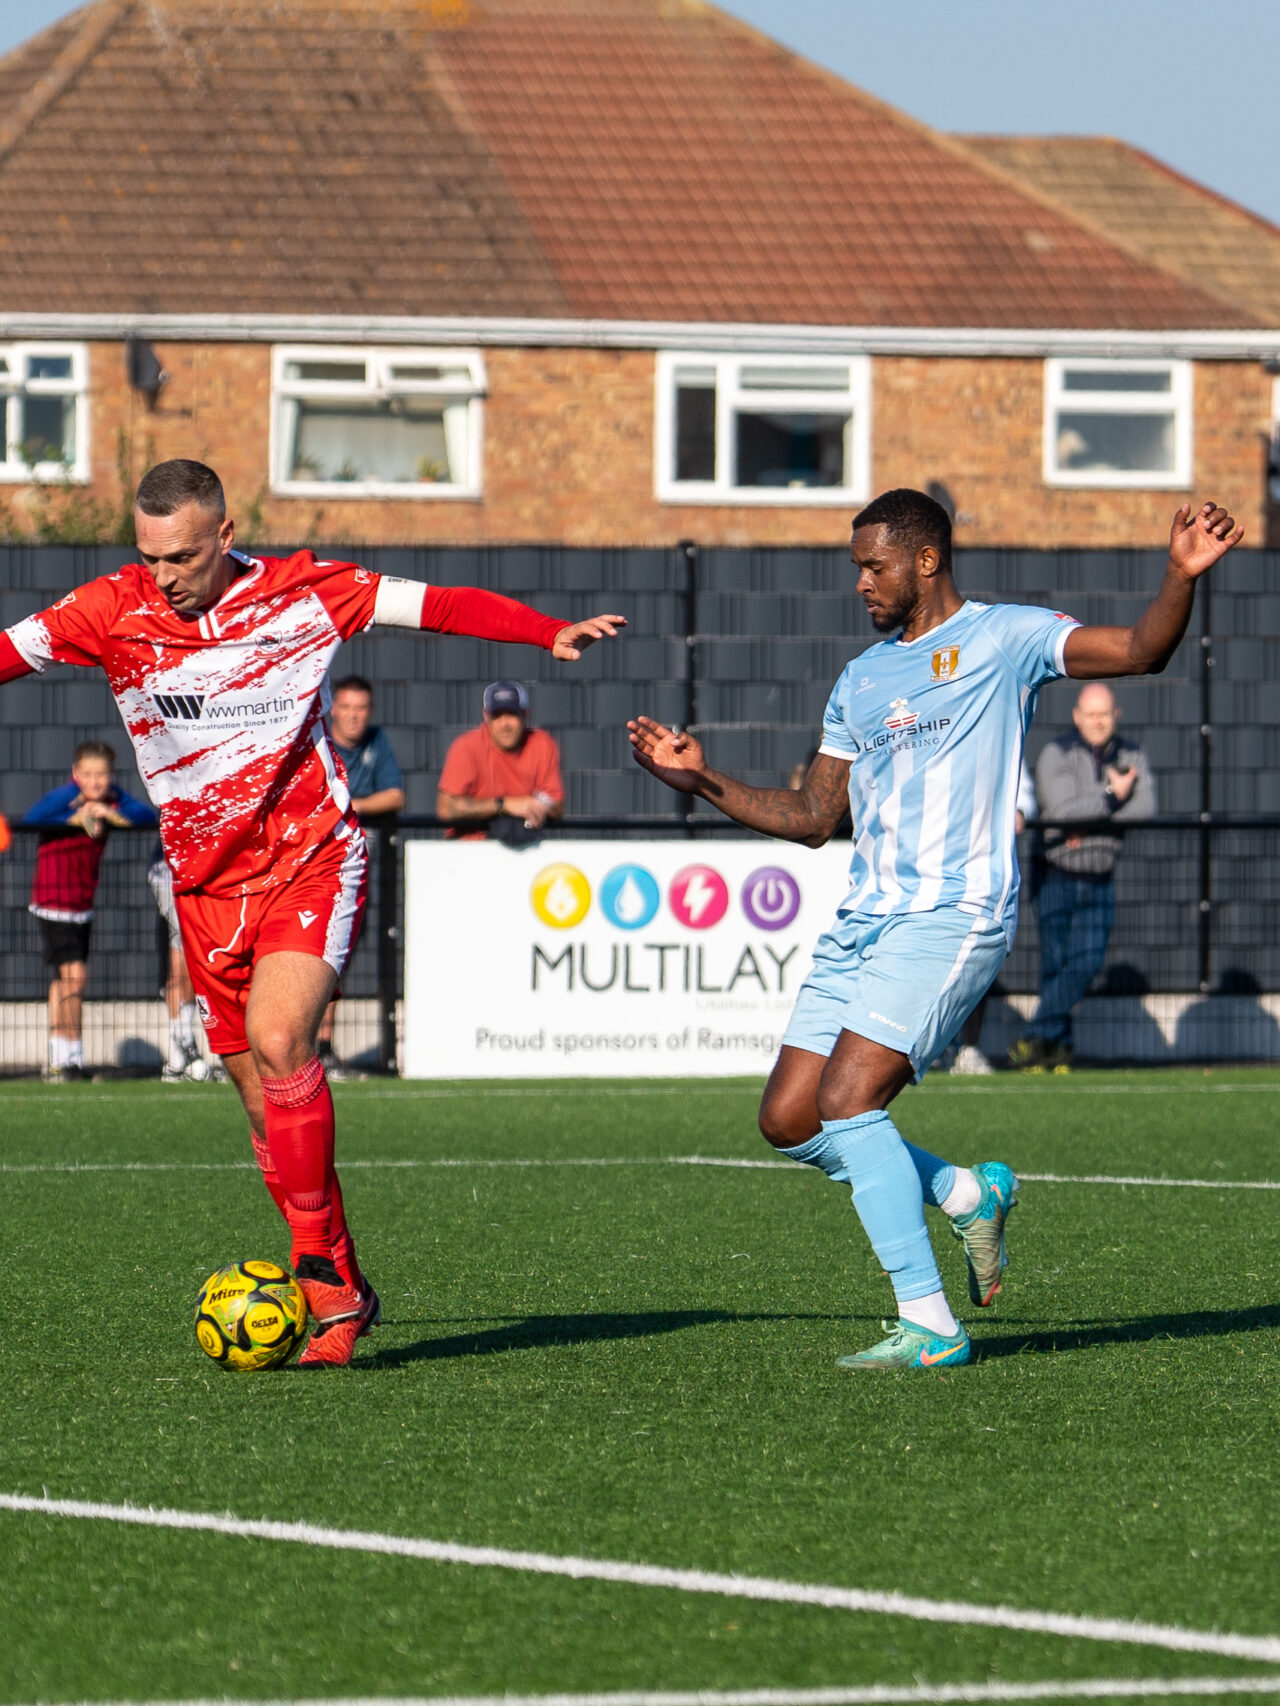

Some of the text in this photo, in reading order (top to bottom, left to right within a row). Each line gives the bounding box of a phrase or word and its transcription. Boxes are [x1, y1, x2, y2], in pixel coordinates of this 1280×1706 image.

[205, 696, 294, 719] wwmartin
[191, 722, 240, 731] Construction
[243, 720, 266, 728] Since
[269, 715, 289, 724] 1877
[864, 718, 951, 752] LIGHTSHIP
[530, 943, 800, 993] MULTILAY
[475, 1027, 545, 1051] Proud
[552, 1033, 659, 1056] sponsors
[666, 1027, 689, 1051] of
[208, 1288, 246, 1305] Mitre
